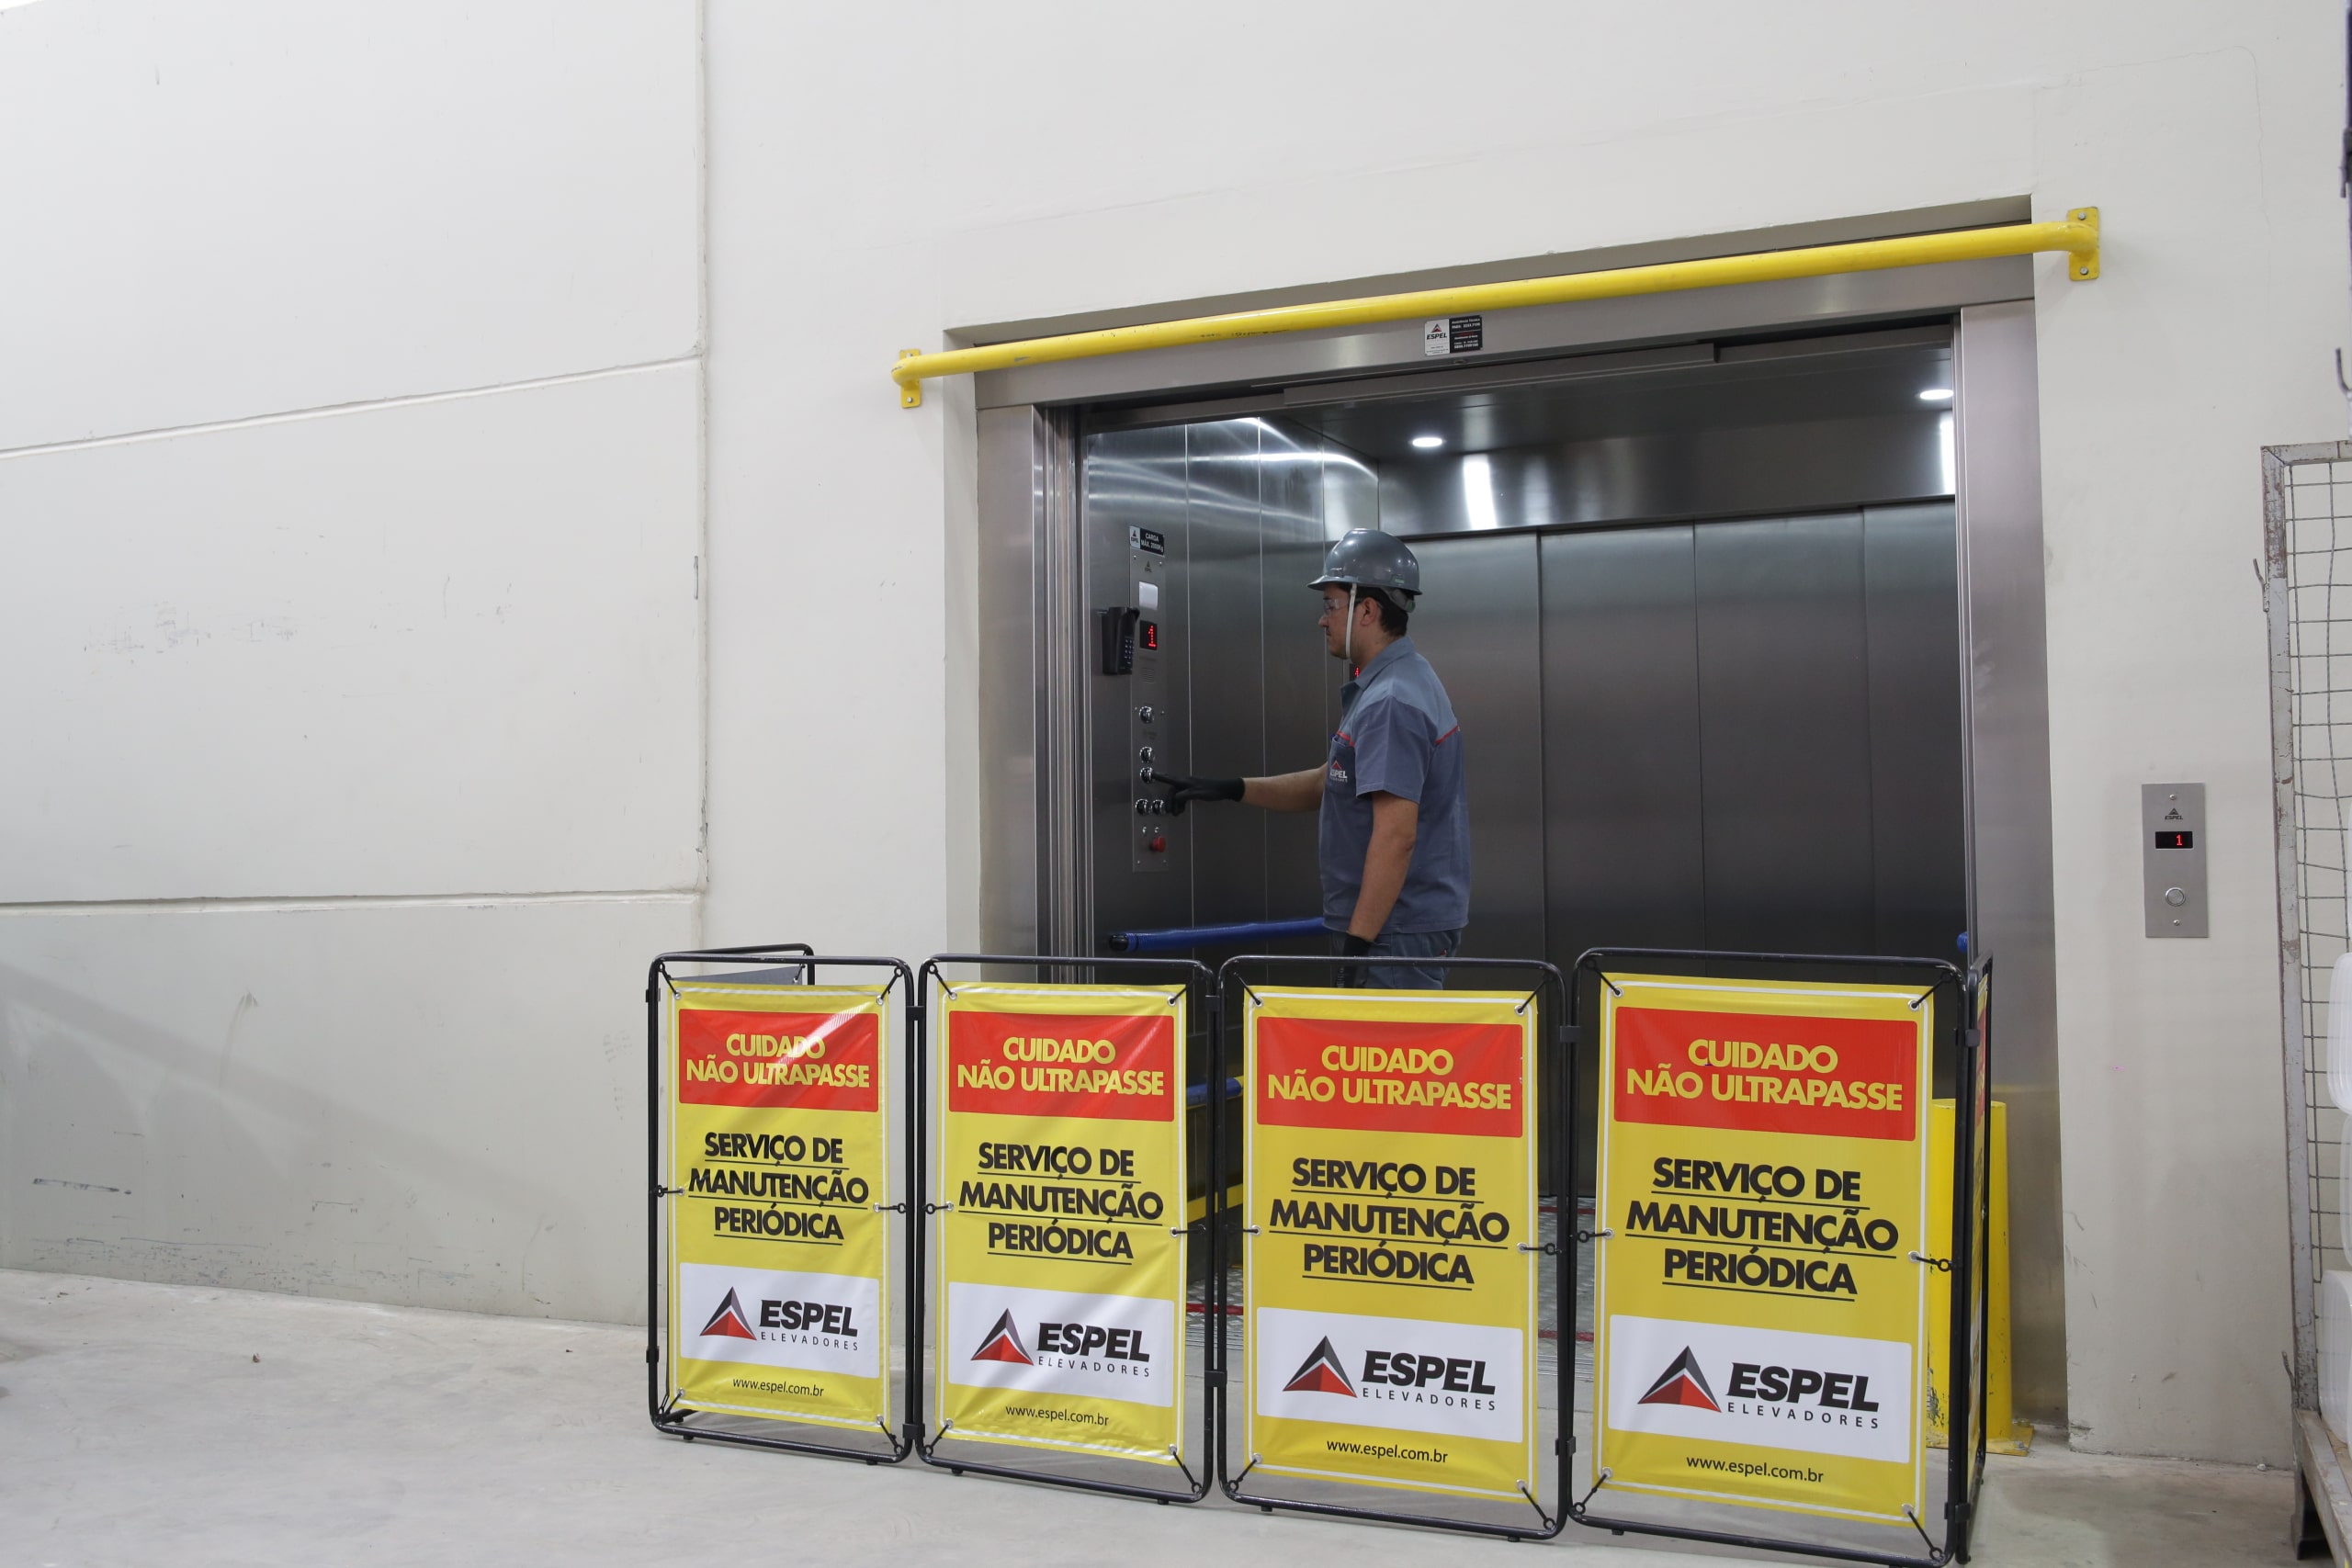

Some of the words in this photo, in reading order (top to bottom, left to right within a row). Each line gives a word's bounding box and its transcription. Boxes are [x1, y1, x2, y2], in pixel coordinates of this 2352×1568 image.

[1148, 626, 1157, 648] 1
[2176, 834, 2183, 845] 1
[726, 1033, 826, 1059] CUIDADO
[1003, 1036, 1116, 1064] CUIDADO
[1321, 1045, 1453, 1076] CUIDADO
[1688, 1039, 1838, 1074] CUIDADO
[686, 1054, 739, 1083] NÃO
[743, 1062, 870, 1088] ULTRAPASSE
[957, 1058, 1015, 1090] NÃO
[1021, 1067, 1164, 1095] ULTRAPASSE
[1268, 1068, 1336, 1102] NÃO
[1342, 1077, 1511, 1110] ULTRAPASSE
[1627, 1062, 1703, 1099] NÃO
[1711, 1074, 1903, 1111] ULTRAPASSE
[705, 1132, 806, 1167] SERVIÇO
[812, 1137, 842, 1163] DE
[978, 1142, 1091, 1180] SERVIÇO
[1100, 1148, 1134, 1177] DE
[689, 1168, 869, 1207] MANUTENÇÃO
[1292, 1157, 1427, 1200] SERVIÇO
[1435, 1166, 1476, 1196] DE
[1653, 1156, 1805, 1203] SERVIÇO
[1815, 1168, 1860, 1202] DE
[715, 1201, 844, 1240] PERIÓDICA
[958, 1180, 1163, 1224] MANUTENÇÃO
[989, 1218, 1134, 1259] PERIÓDICA
[1270, 1199, 1510, 1247] MANUTENÇÃO
[1626, 1201, 1899, 1255] MANUTENÇÃO
[1304, 1239, 1475, 1284] PERIÓDICA
[1664, 1245, 1858, 1295] PERIÓDICA
[759, 1299, 859, 1337] ESPEL
[761, 1332, 858, 1351] ELEVADORES
[1036, 1323, 1149, 1362] ESPEL
[1038, 1356, 1149, 1378] ELEVADORES
[1361, 1350, 1496, 1395] ESPEL
[732, 1378, 824, 1397] www.espel.com.br
[1363, 1388, 1496, 1411] ELEVADORES
[1725, 1362, 1880, 1413] ESPEL
[1005, 1405, 1109, 1426] www.espel.com.br
[1727, 1402, 1878, 1429] ELEVADORES
[1327, 1440, 1448, 1463] www.espel.com.br
[1686, 1456, 1824, 1483] www.espel.com.br
